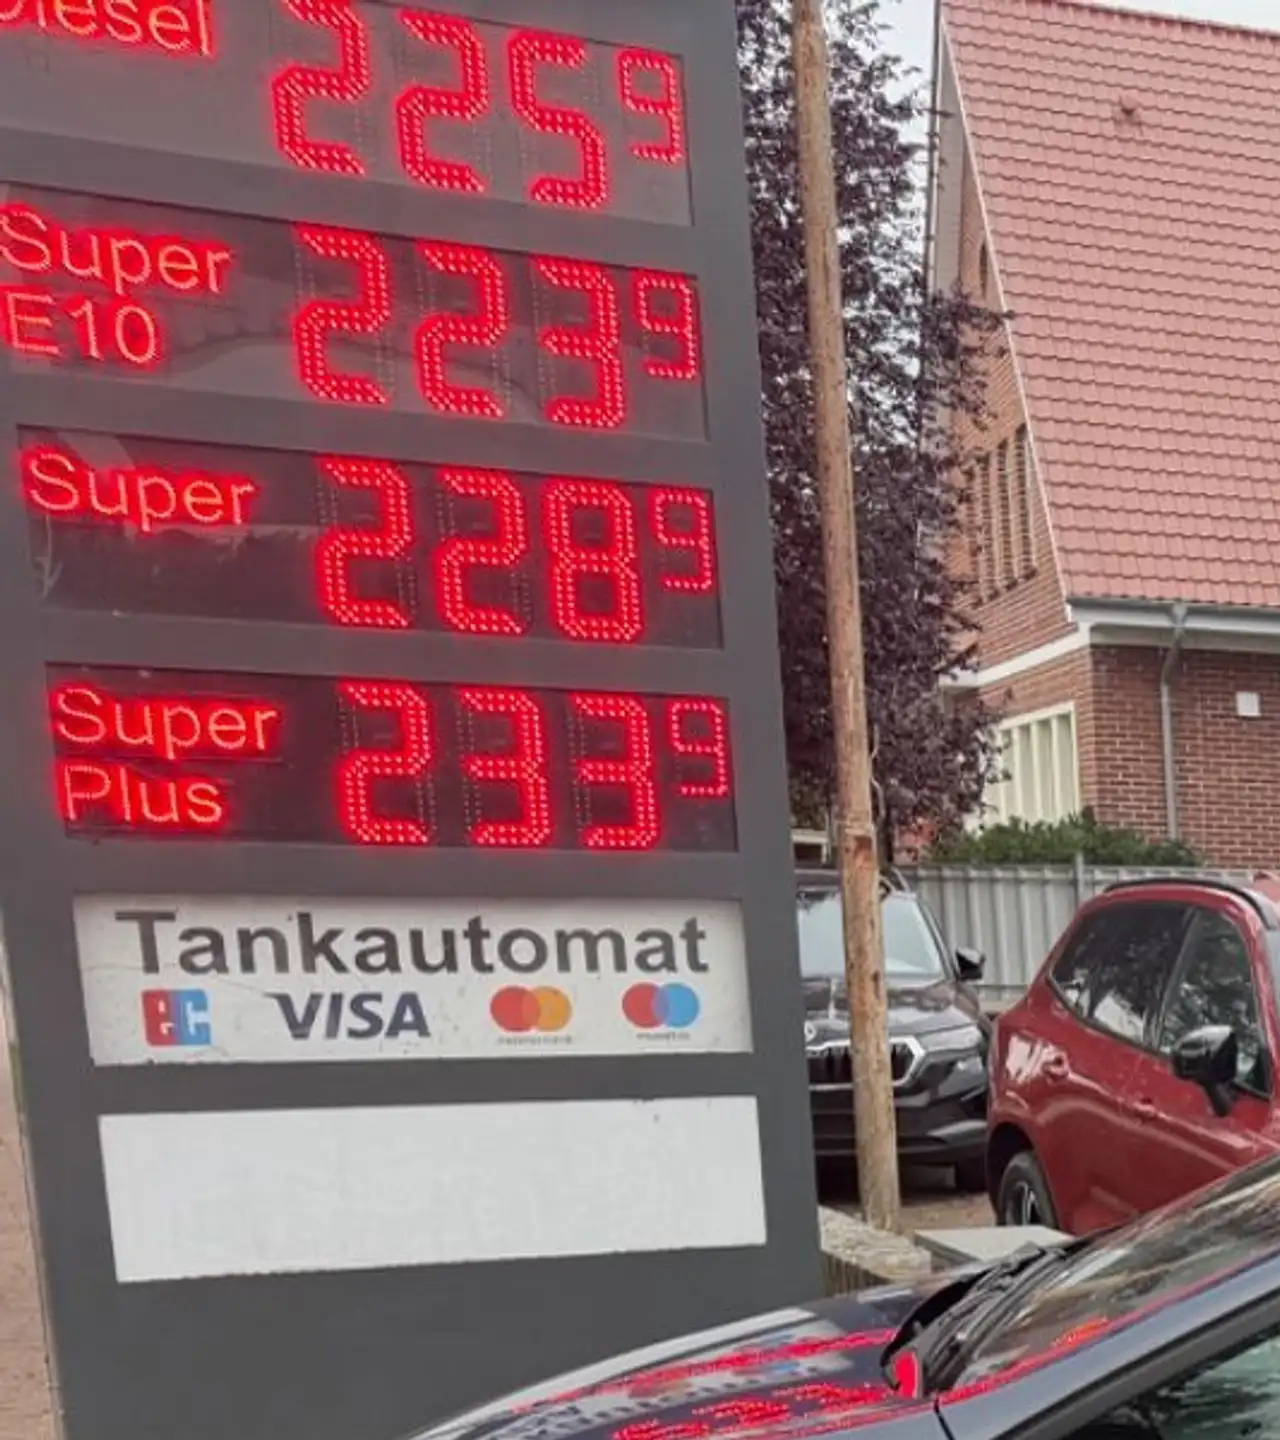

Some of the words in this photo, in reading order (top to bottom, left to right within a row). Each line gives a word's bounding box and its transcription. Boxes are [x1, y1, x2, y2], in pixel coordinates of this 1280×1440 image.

[0, 0, 212, 55] esel
[0, 211, 230, 294] Super
[4, 292, 157, 364] E10
[28, 451, 254, 532] Super
[57, 688, 277, 759] Super
[63, 764, 222, 823] Plus
[115, 910, 709, 975] Tankautomat
[273, 991, 431, 1039] VISA
